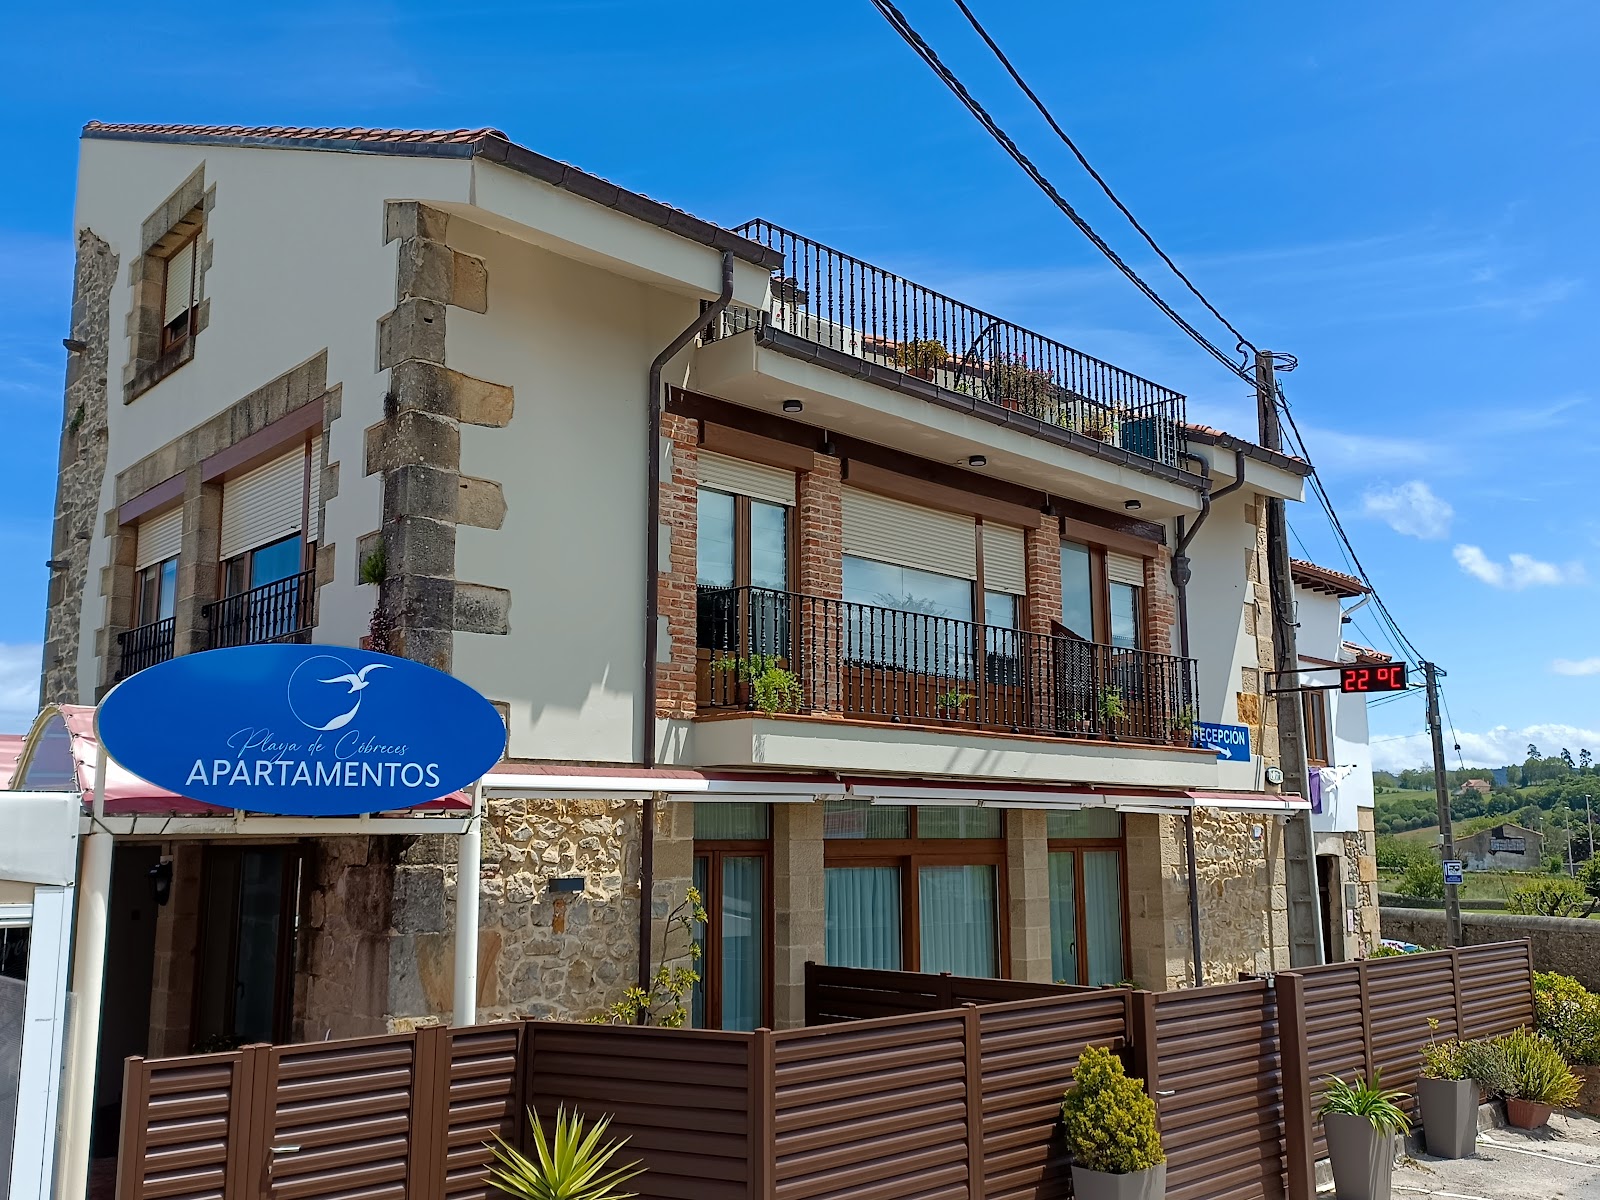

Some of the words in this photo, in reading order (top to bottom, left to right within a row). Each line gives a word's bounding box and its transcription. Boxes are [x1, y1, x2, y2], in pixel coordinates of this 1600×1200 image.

[1345, 670, 1368, 690] 22
[227, 727, 302, 764] Playa
[308, 734, 326, 756] de
[1192, 726, 1246, 746] RECEPCIÓN
[185, 759, 440, 788] APARTAMENTOS
